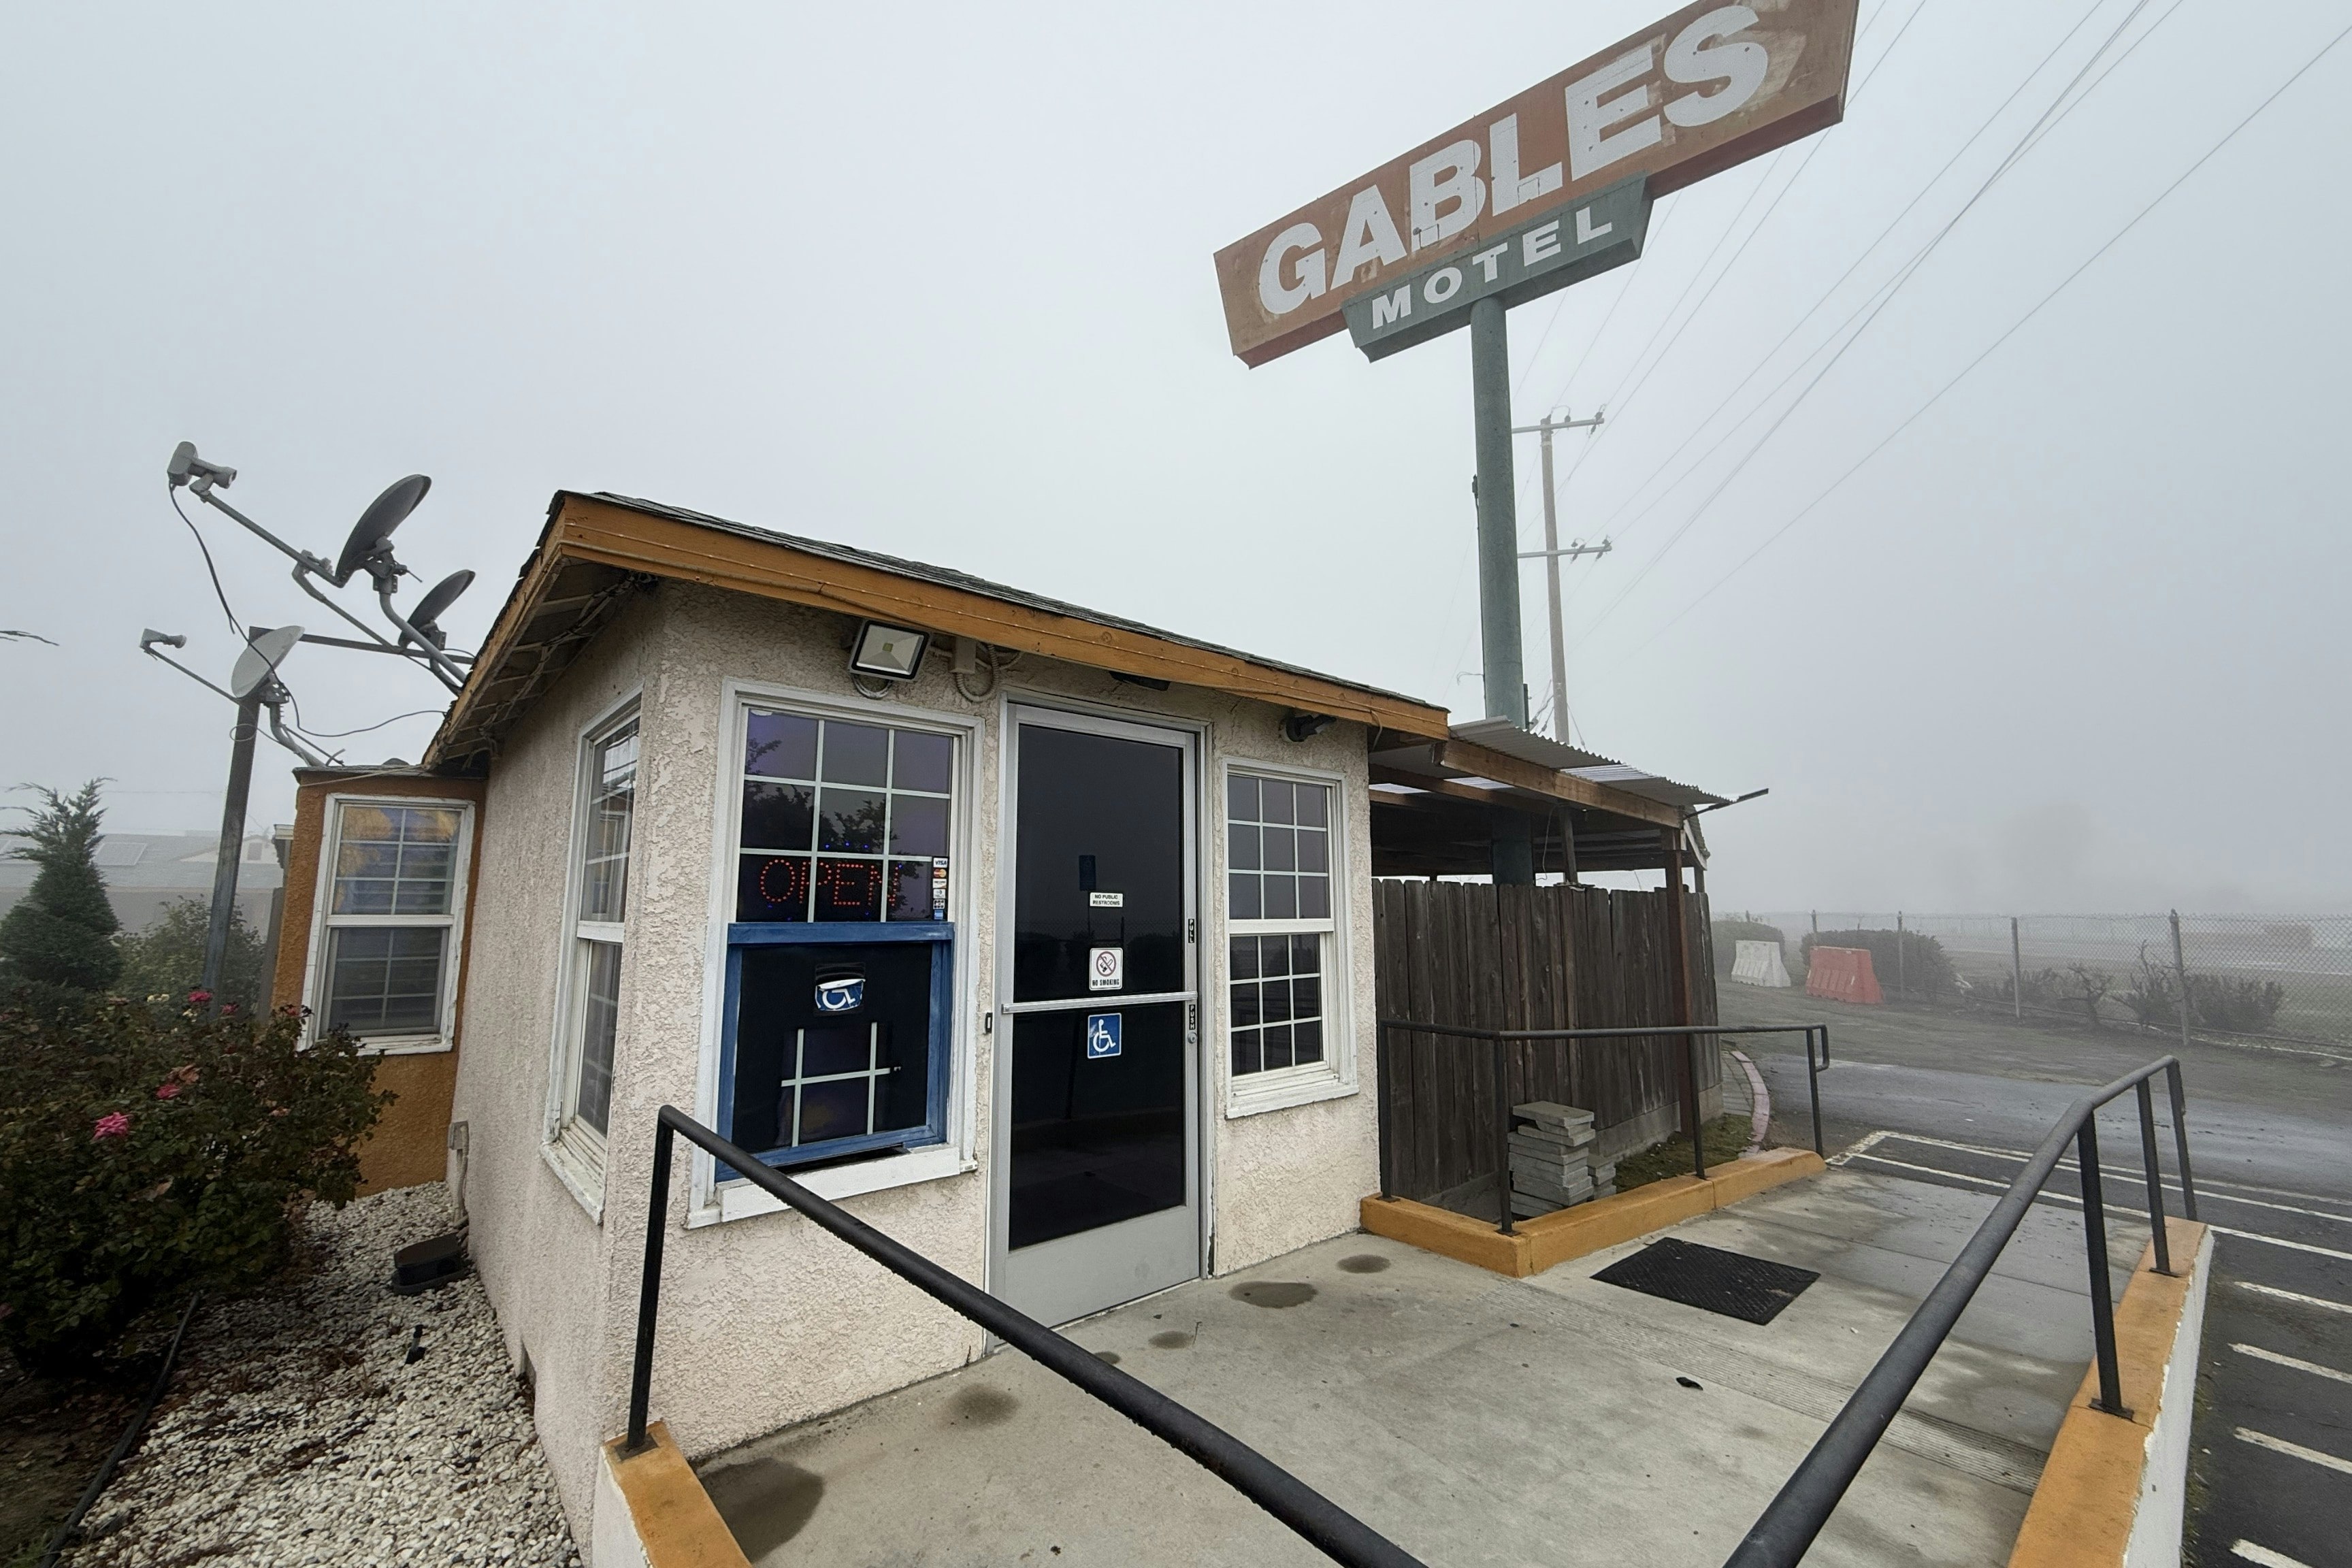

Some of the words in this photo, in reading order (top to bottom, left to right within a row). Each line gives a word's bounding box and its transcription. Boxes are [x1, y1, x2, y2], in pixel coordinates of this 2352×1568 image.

[1258, 5, 1768, 315] GABLES
[1372, 206, 1613, 329] MOTEL
[760, 859, 900, 906] OPEN
